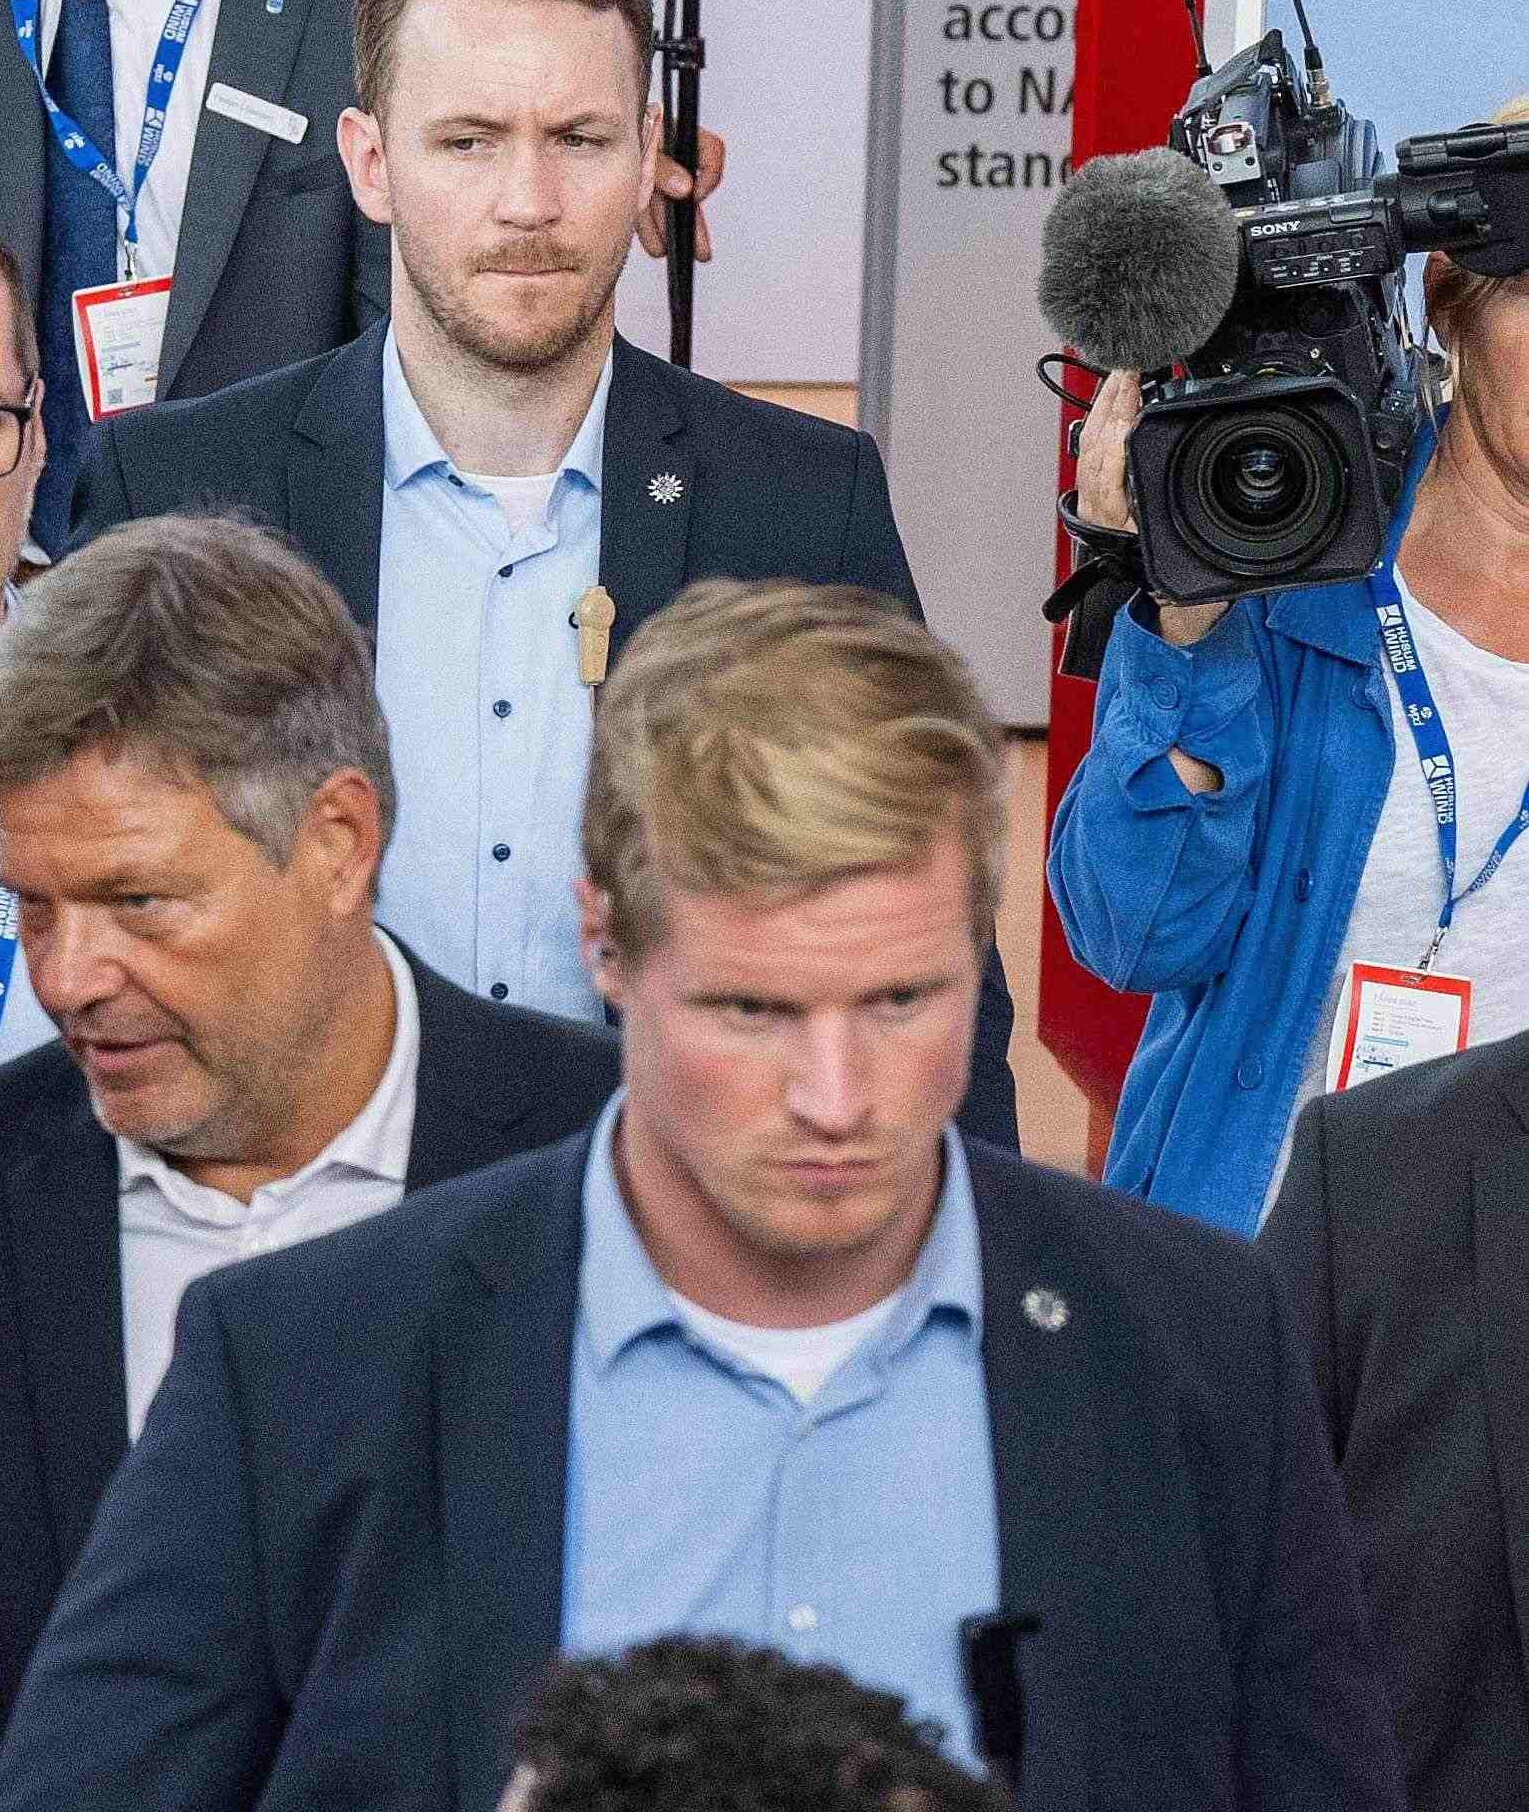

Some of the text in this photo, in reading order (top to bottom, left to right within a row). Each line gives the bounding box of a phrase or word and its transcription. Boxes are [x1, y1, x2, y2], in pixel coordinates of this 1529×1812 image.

[942, 4, 1075, 41] acco
[938, 69, 994, 116] to
[1250, 220, 1301, 237] SONY
[1382, 628, 1407, 674] WIND
[1395, 626, 1418, 672] HUSUM
[1429, 779, 1447, 825] WIND
